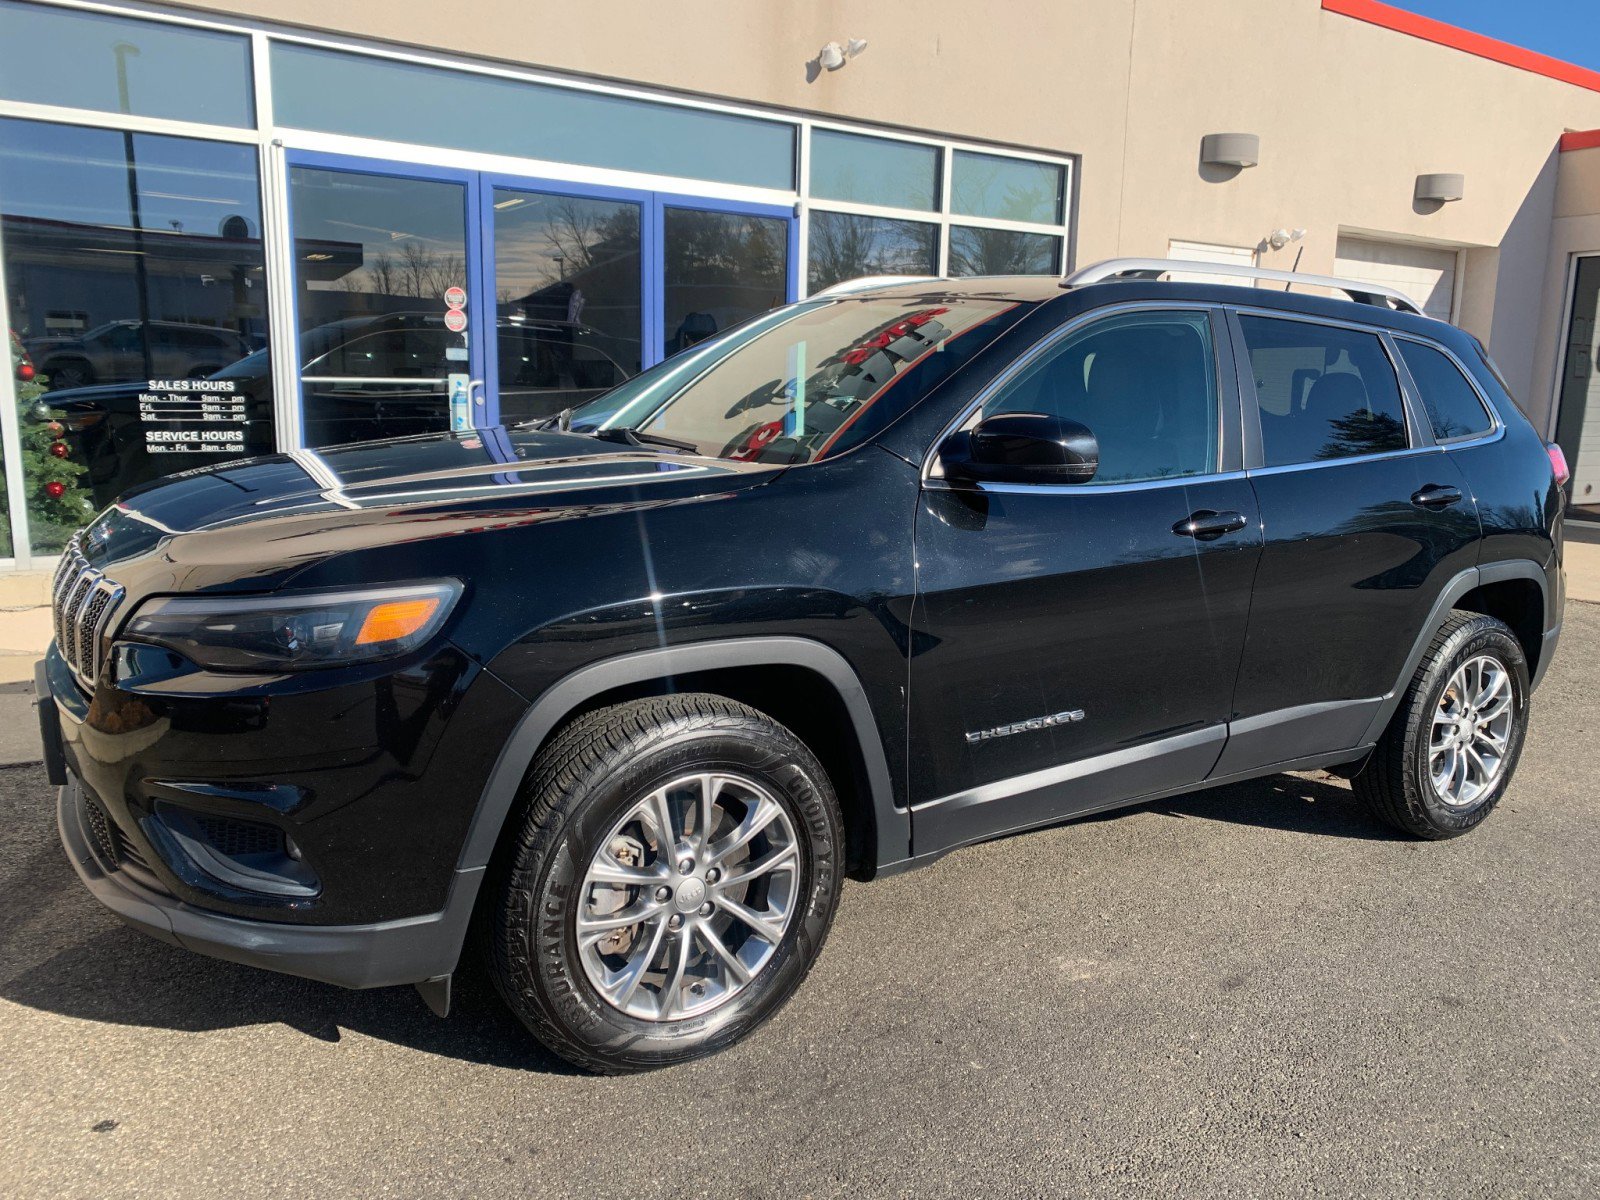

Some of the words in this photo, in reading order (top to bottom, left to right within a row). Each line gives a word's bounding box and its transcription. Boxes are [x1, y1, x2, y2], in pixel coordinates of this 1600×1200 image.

[148, 380, 189, 390] SALES
[192, 381, 235, 391] HOURS
[139, 394, 160, 402] Mon.
[168, 394, 190, 402] Thur.
[201, 394, 220, 402] 9am
[140, 403, 154, 411] Fri.
[140, 412, 157, 420] Sat.
[146, 431, 198, 441] SERVICE
[201, 431, 243, 441] HOURS
[147, 444, 168, 452] Mon.
[175, 444, 189, 452] Fri.
[201, 444, 219, 452] 8am
[226, 443, 244, 452] 6pm
